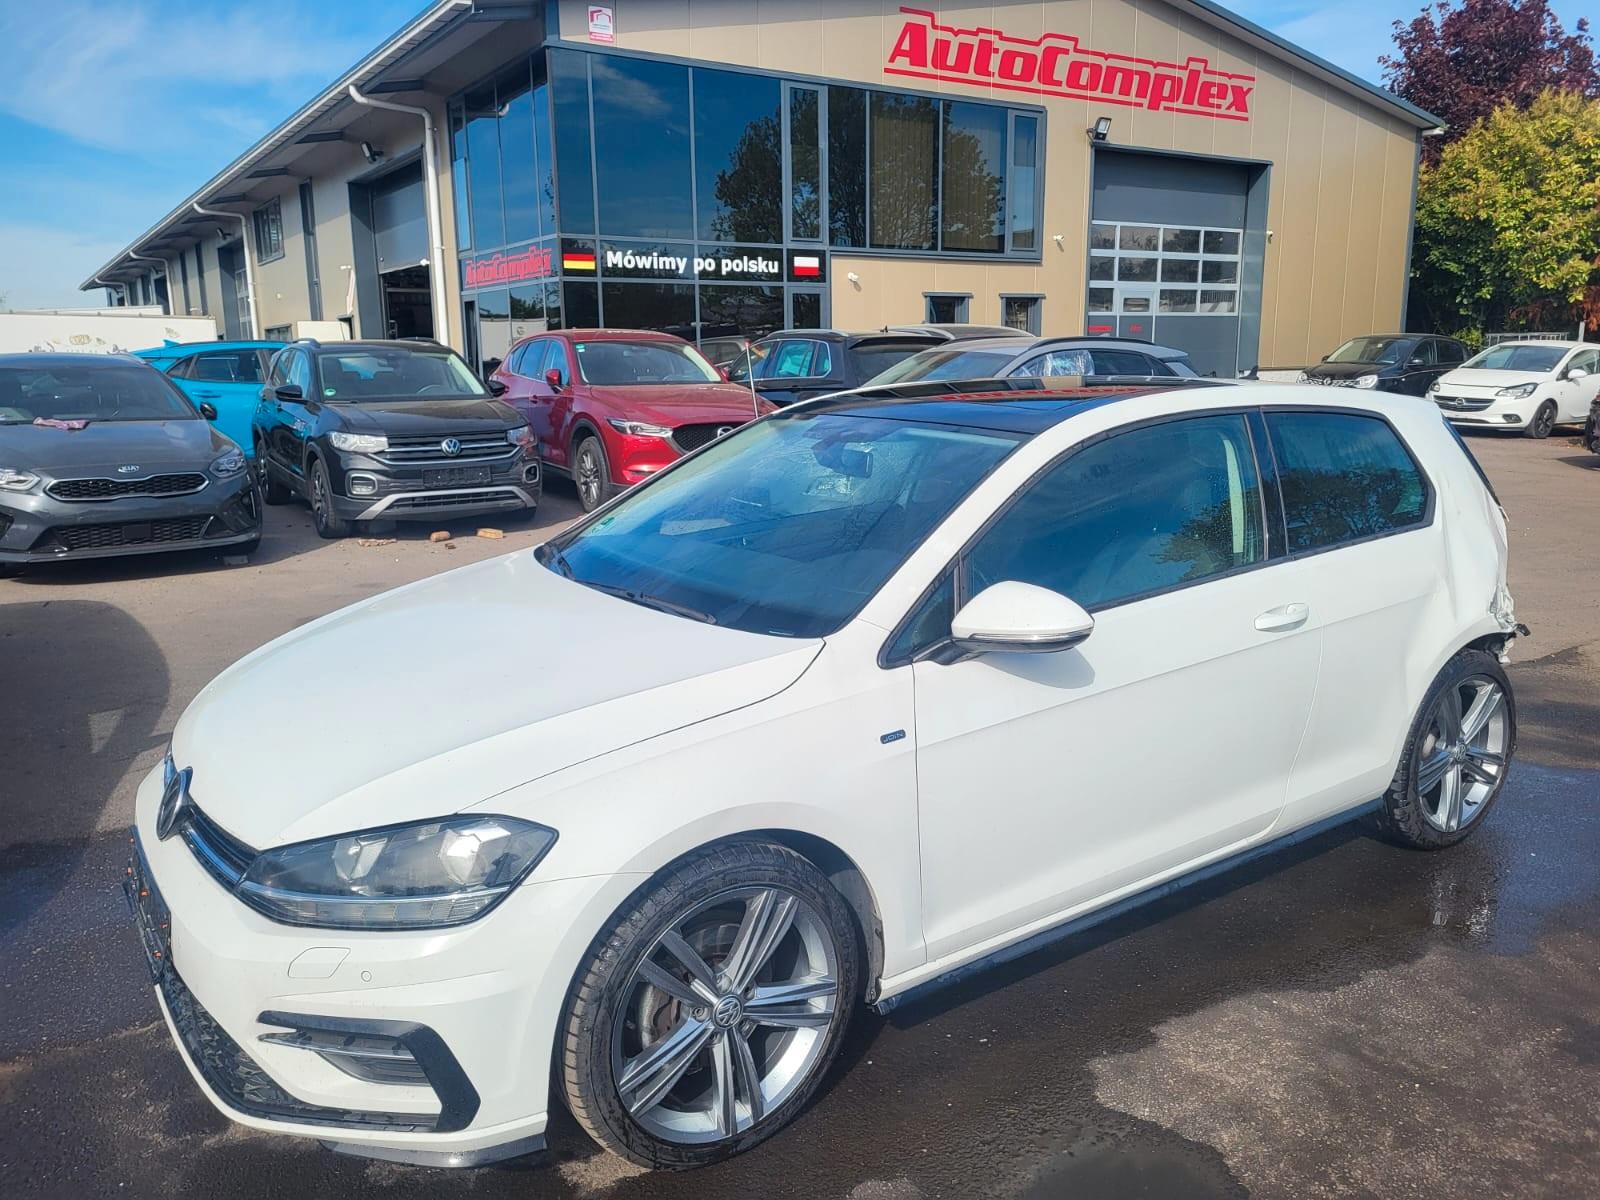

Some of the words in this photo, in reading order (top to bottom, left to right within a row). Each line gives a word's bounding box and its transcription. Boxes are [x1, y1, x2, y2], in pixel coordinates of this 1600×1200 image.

[887, 20, 1254, 113] AutoComplex
[606, 250, 687, 274] Mówimy
[693, 257, 716, 274] po
[721, 256, 779, 276] polsku
